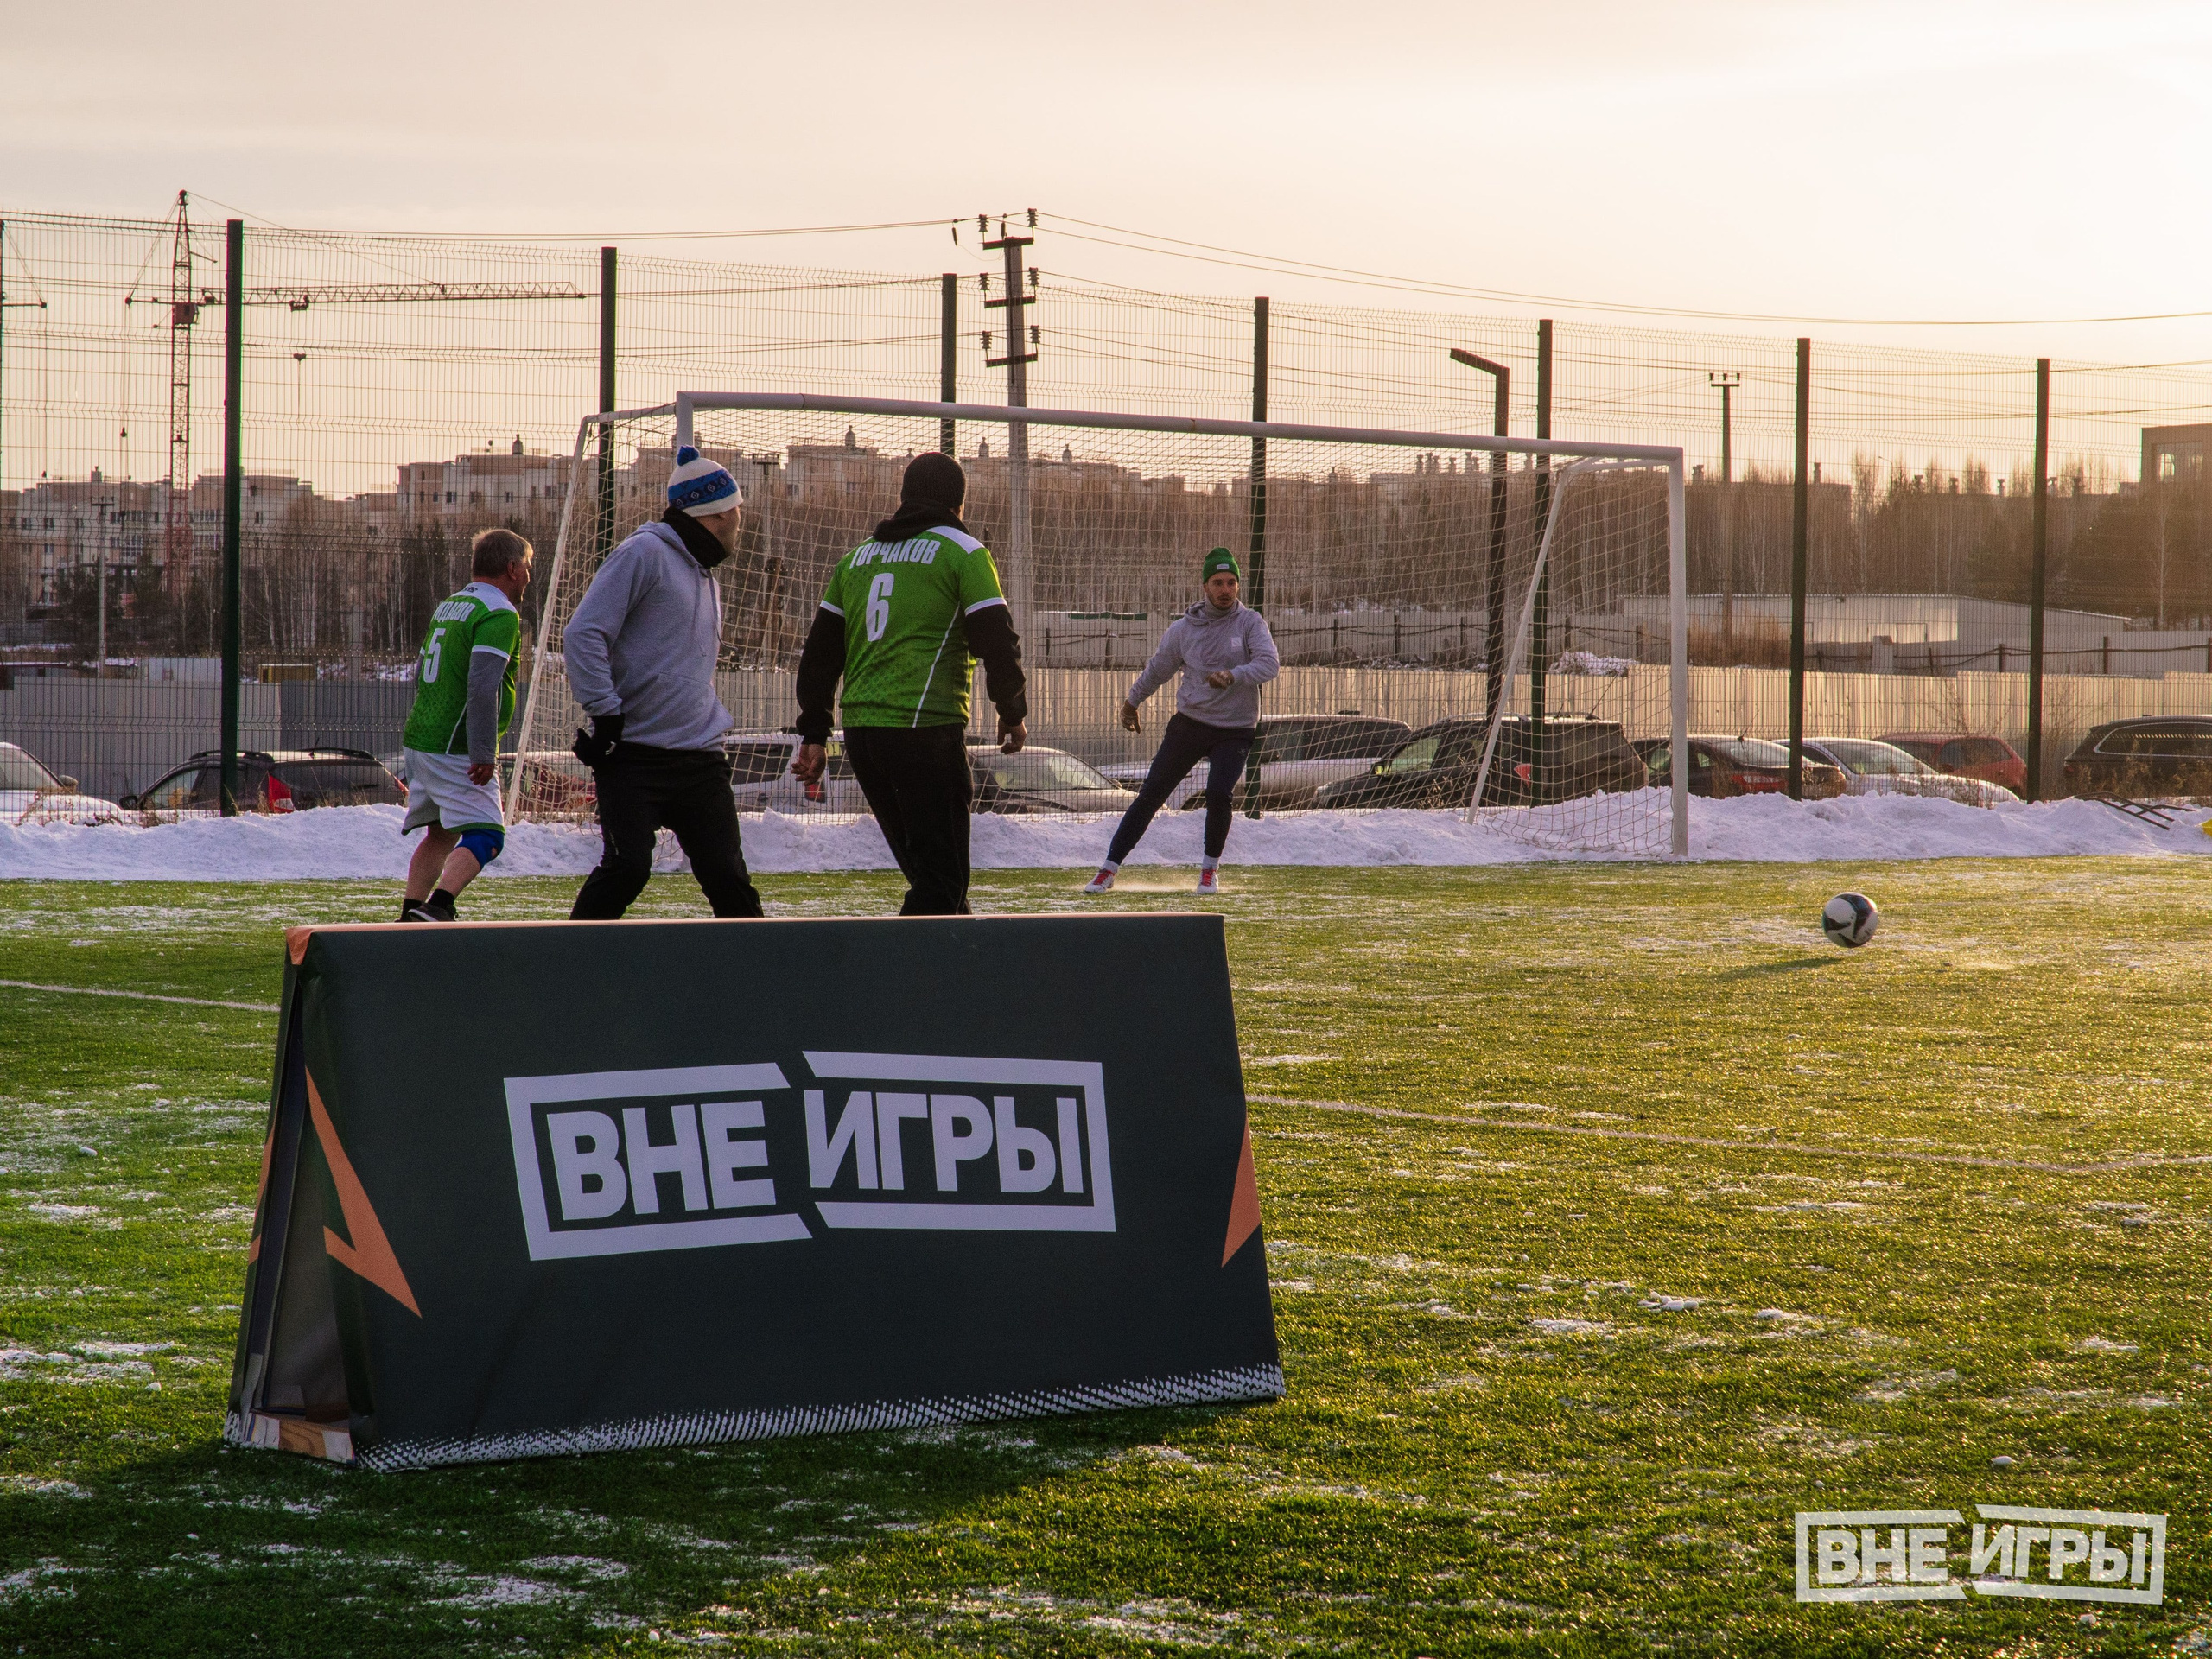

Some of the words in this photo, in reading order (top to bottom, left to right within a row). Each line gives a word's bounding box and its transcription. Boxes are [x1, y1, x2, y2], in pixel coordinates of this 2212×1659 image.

[849, 538, 941, 569] ГОРЧАКОВ
[866, 573, 894, 642] 6
[423, 627, 446, 683] 5
[546, 1100, 776, 1220] ВНЕ
[804, 1090, 1084, 1193] ИГРЫ
